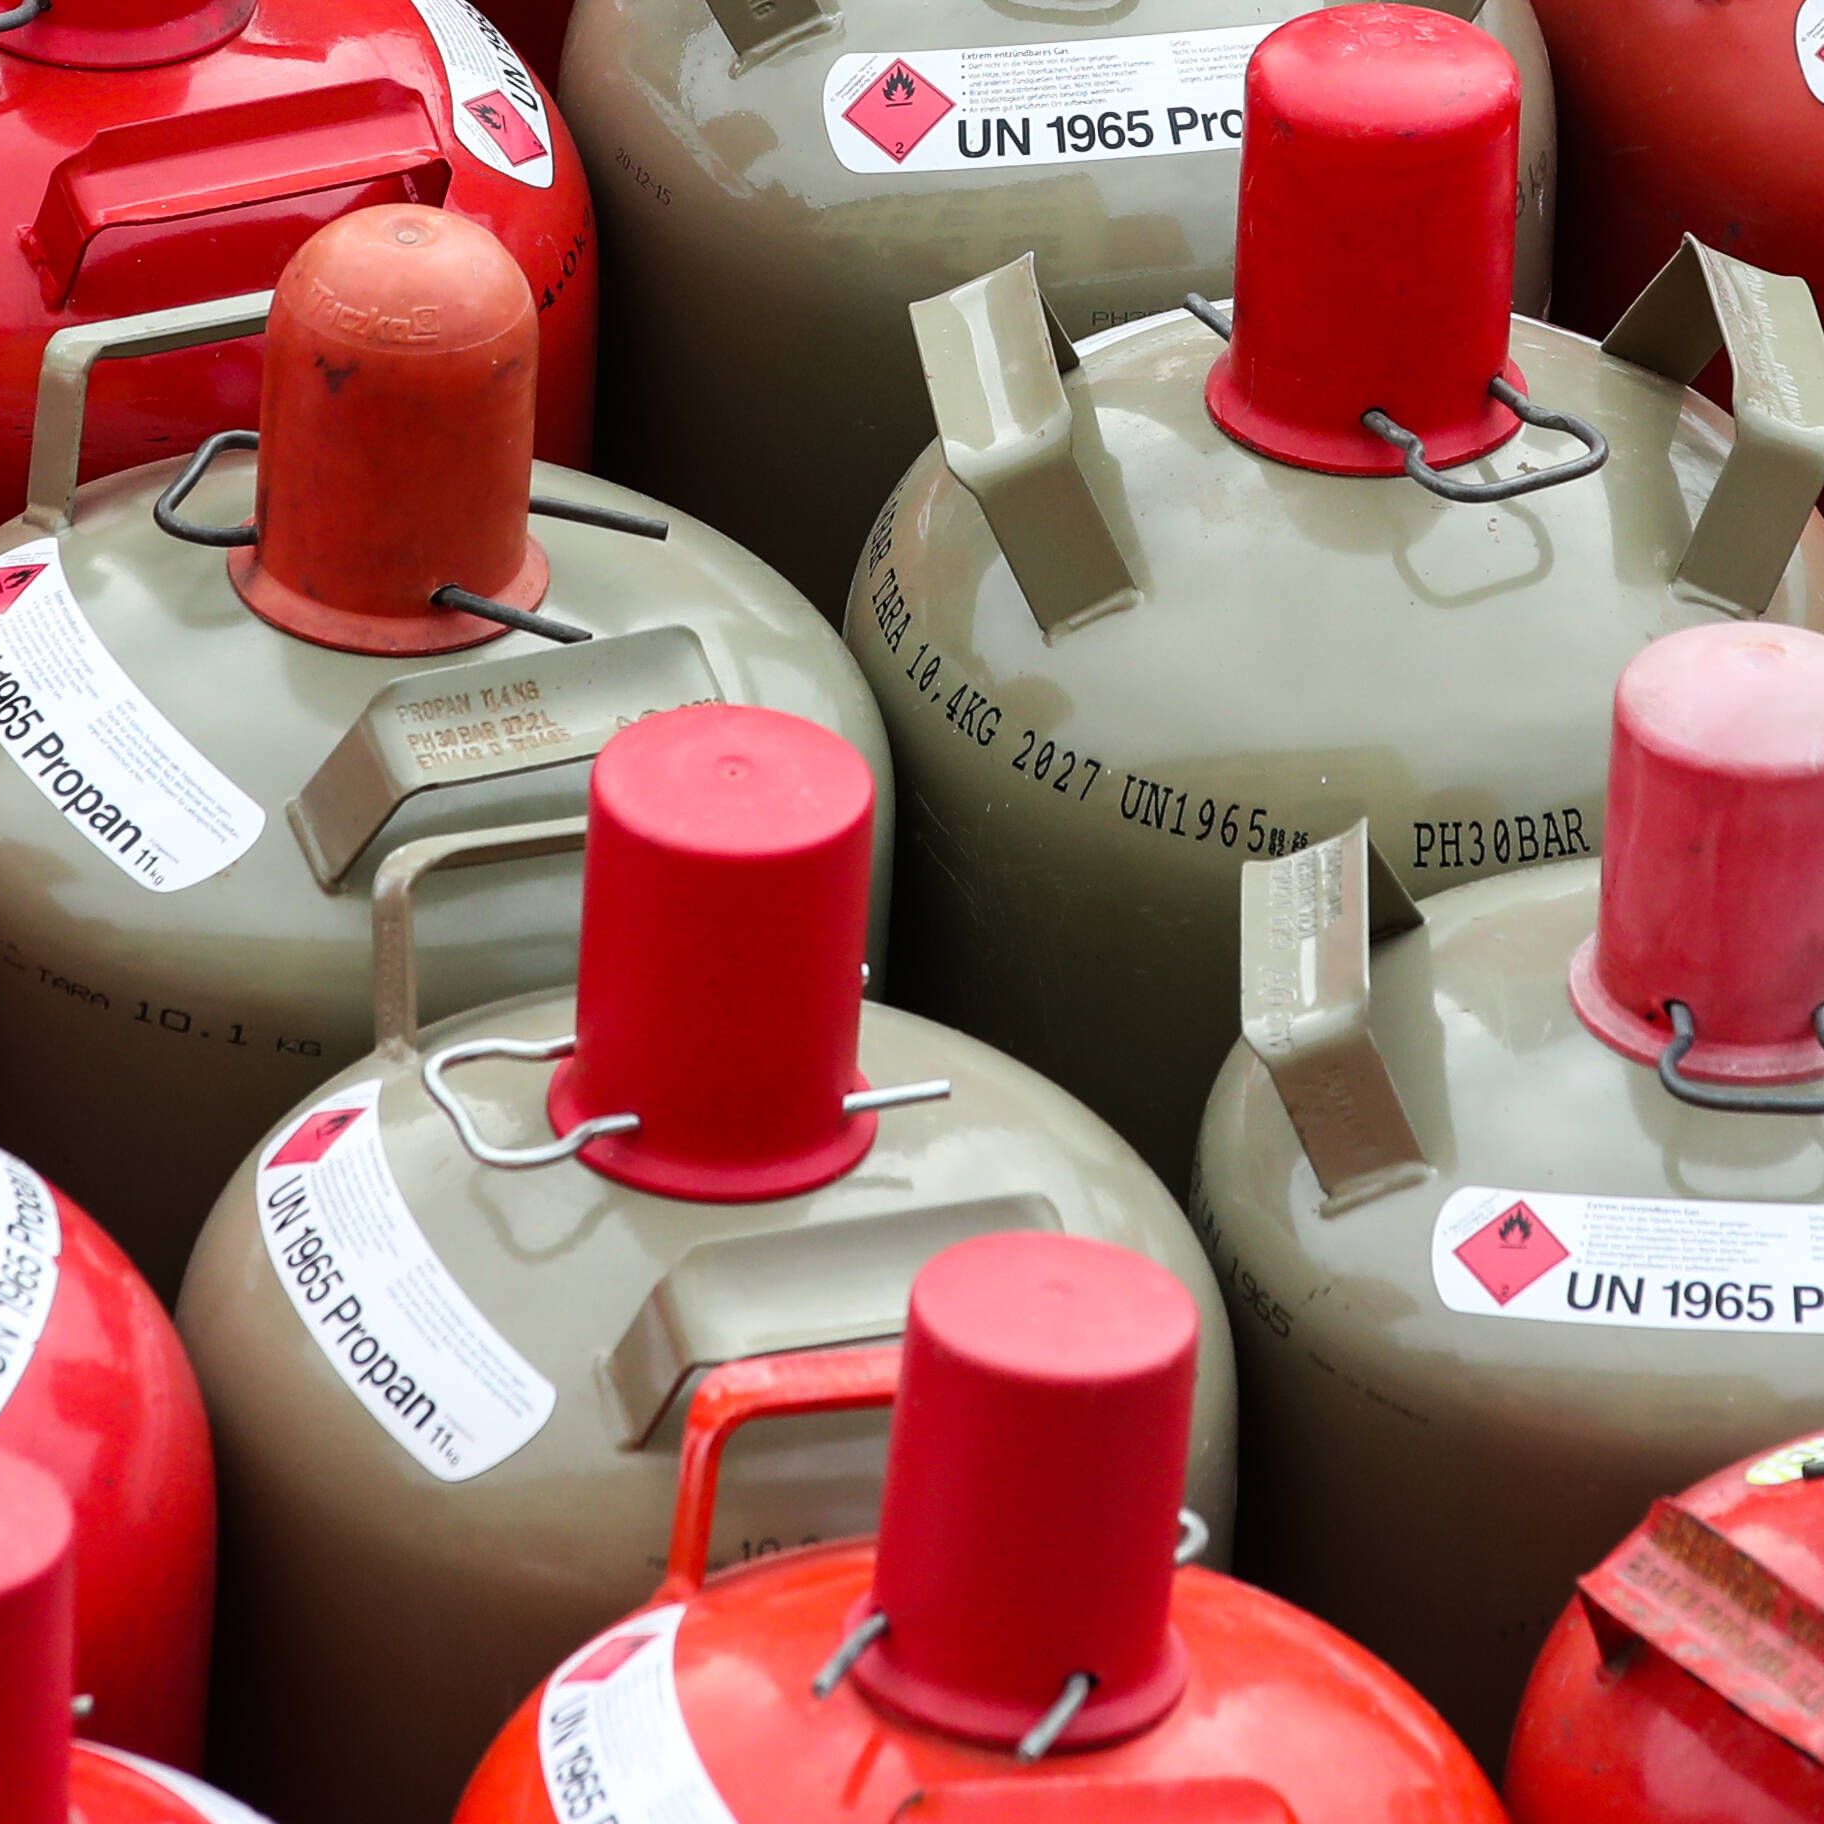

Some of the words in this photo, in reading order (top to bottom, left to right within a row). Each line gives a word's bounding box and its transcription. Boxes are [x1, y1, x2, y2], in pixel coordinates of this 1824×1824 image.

[498, 56, 538, 112] UN
[957, 118, 1031, 159] UN
[1045, 107, 1155, 153] 1965
[397, 692, 473, 724] PROPAN
[870, 567, 909, 654] TARA
[1011, 729, 1102, 802] 2027
[1119, 774, 1267, 855] UN1965
[22, 725, 143, 855] Propan
[1412, 807, 1591, 870] PH30BAR
[37, 966, 112, 1010] TARA
[133, 999, 250, 1048] 10.1
[274, 1033, 323, 1058] KG
[265, 1172, 308, 1235] UN
[281, 1222, 343, 1308] 1965
[1229, 1257, 1295, 1339] 1965
[1565, 1270, 1647, 1315] UN
[1661, 1280, 1775, 1322] 1965
[321, 1293, 439, 1431] Propan
[549, 1690, 590, 1751] UN
[555, 1740, 606, 1822] 1965
